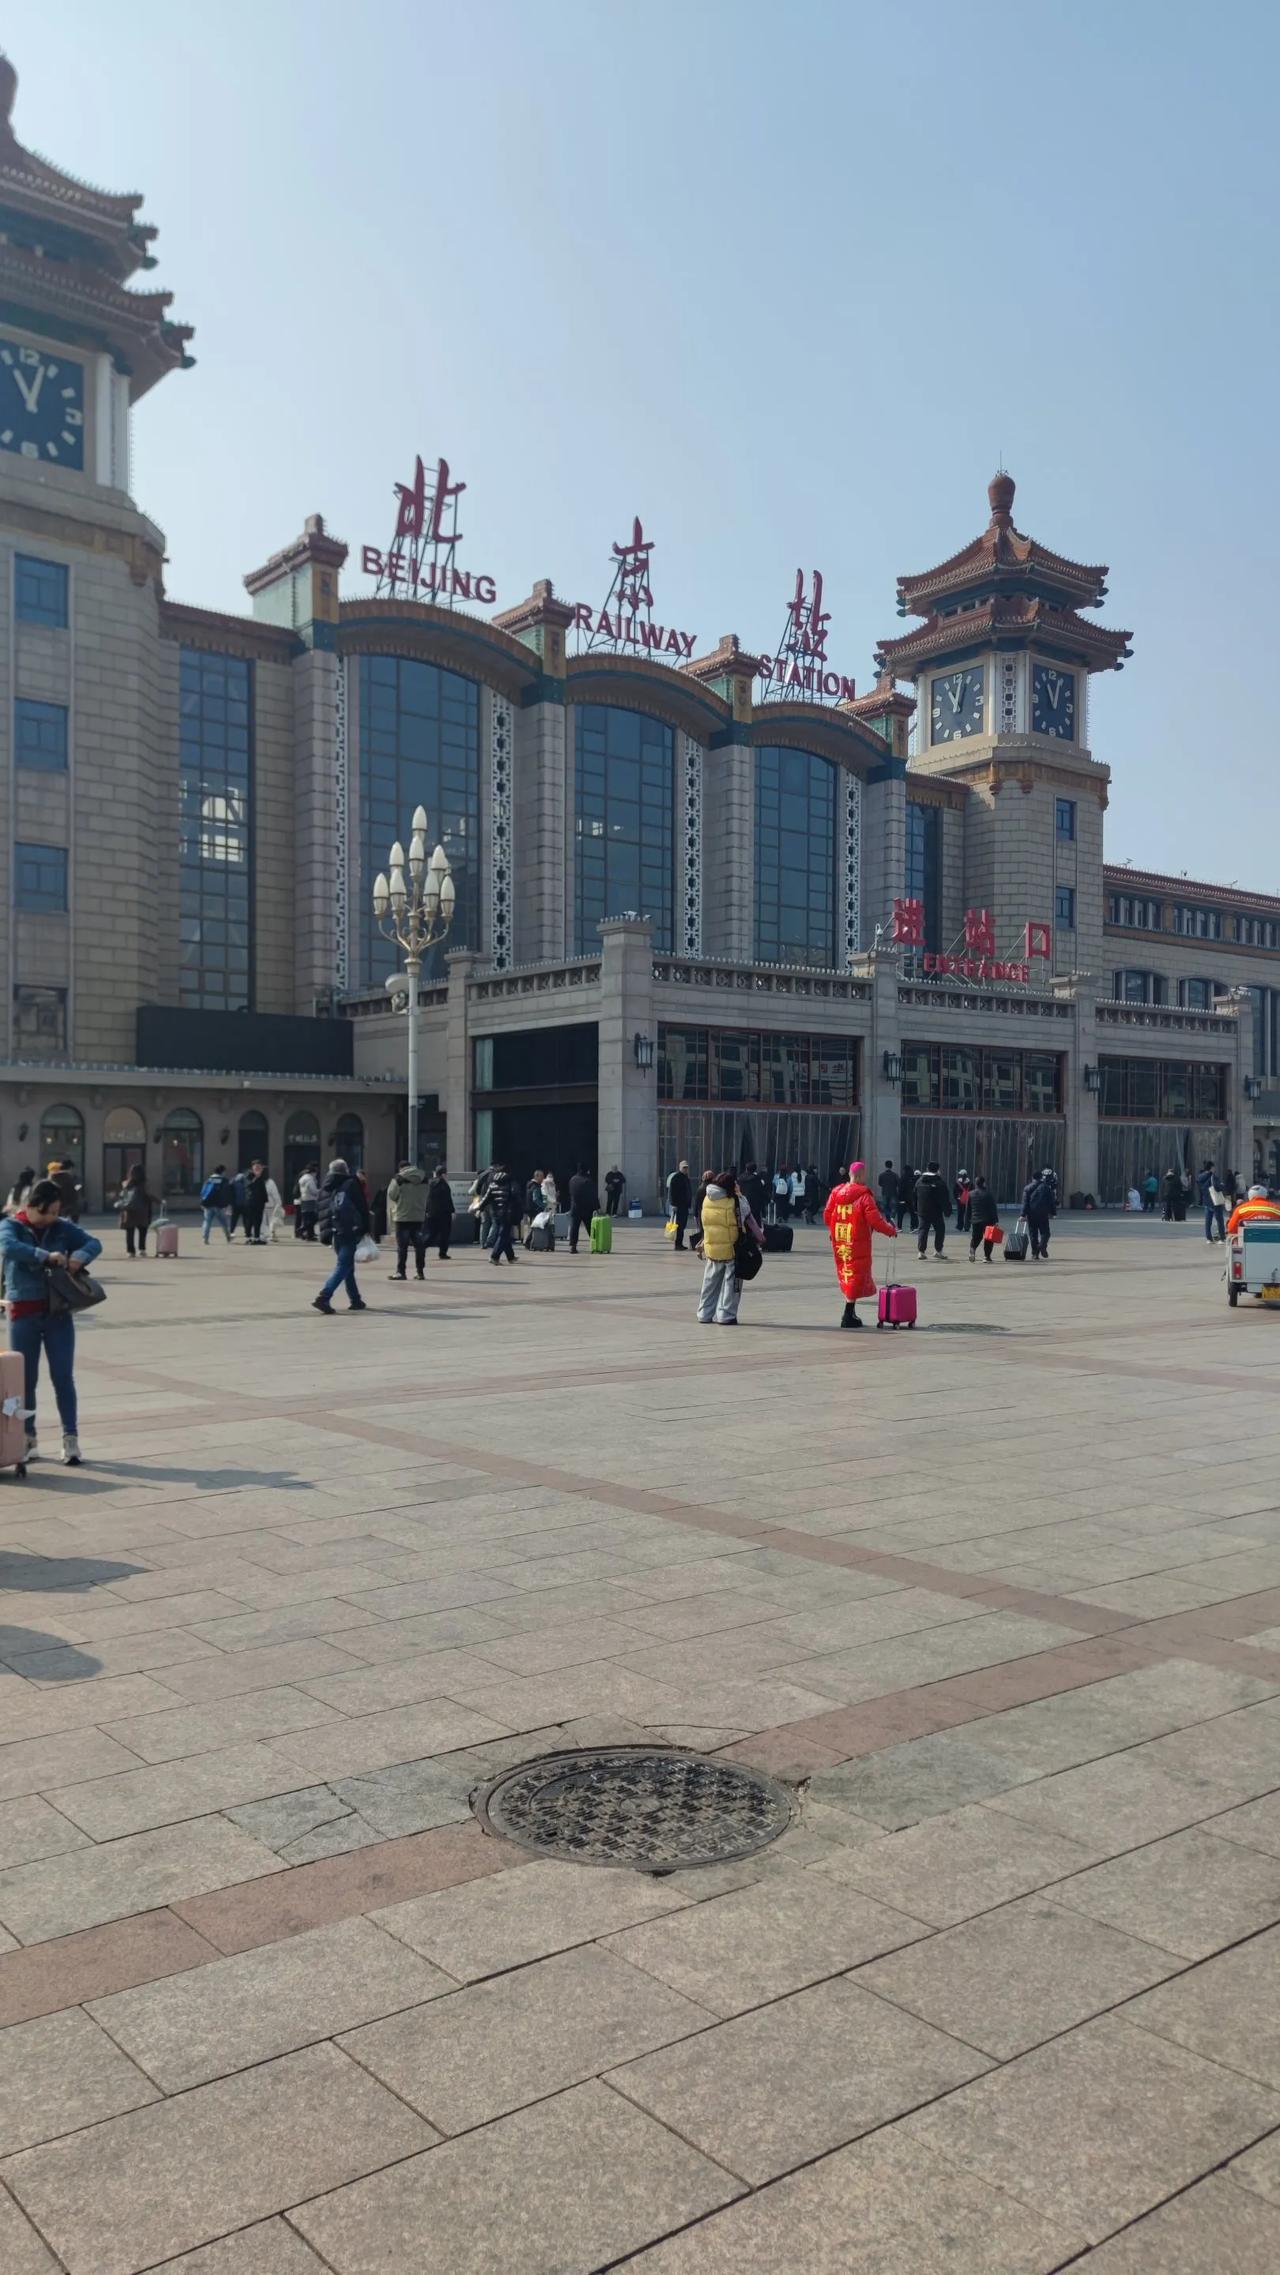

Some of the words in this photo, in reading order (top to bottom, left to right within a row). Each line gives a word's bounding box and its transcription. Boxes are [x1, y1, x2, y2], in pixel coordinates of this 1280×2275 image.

[362, 545, 497, 604] BEIJING
[575, 602, 697, 658] RAILWAY
[758, 654, 855, 701] STATION
[394, 454, 466, 543] 北
[612, 515, 656, 611] 京
[785, 568, 832, 661] 站
[924, 953, 1031, 984] ENTRANCE
